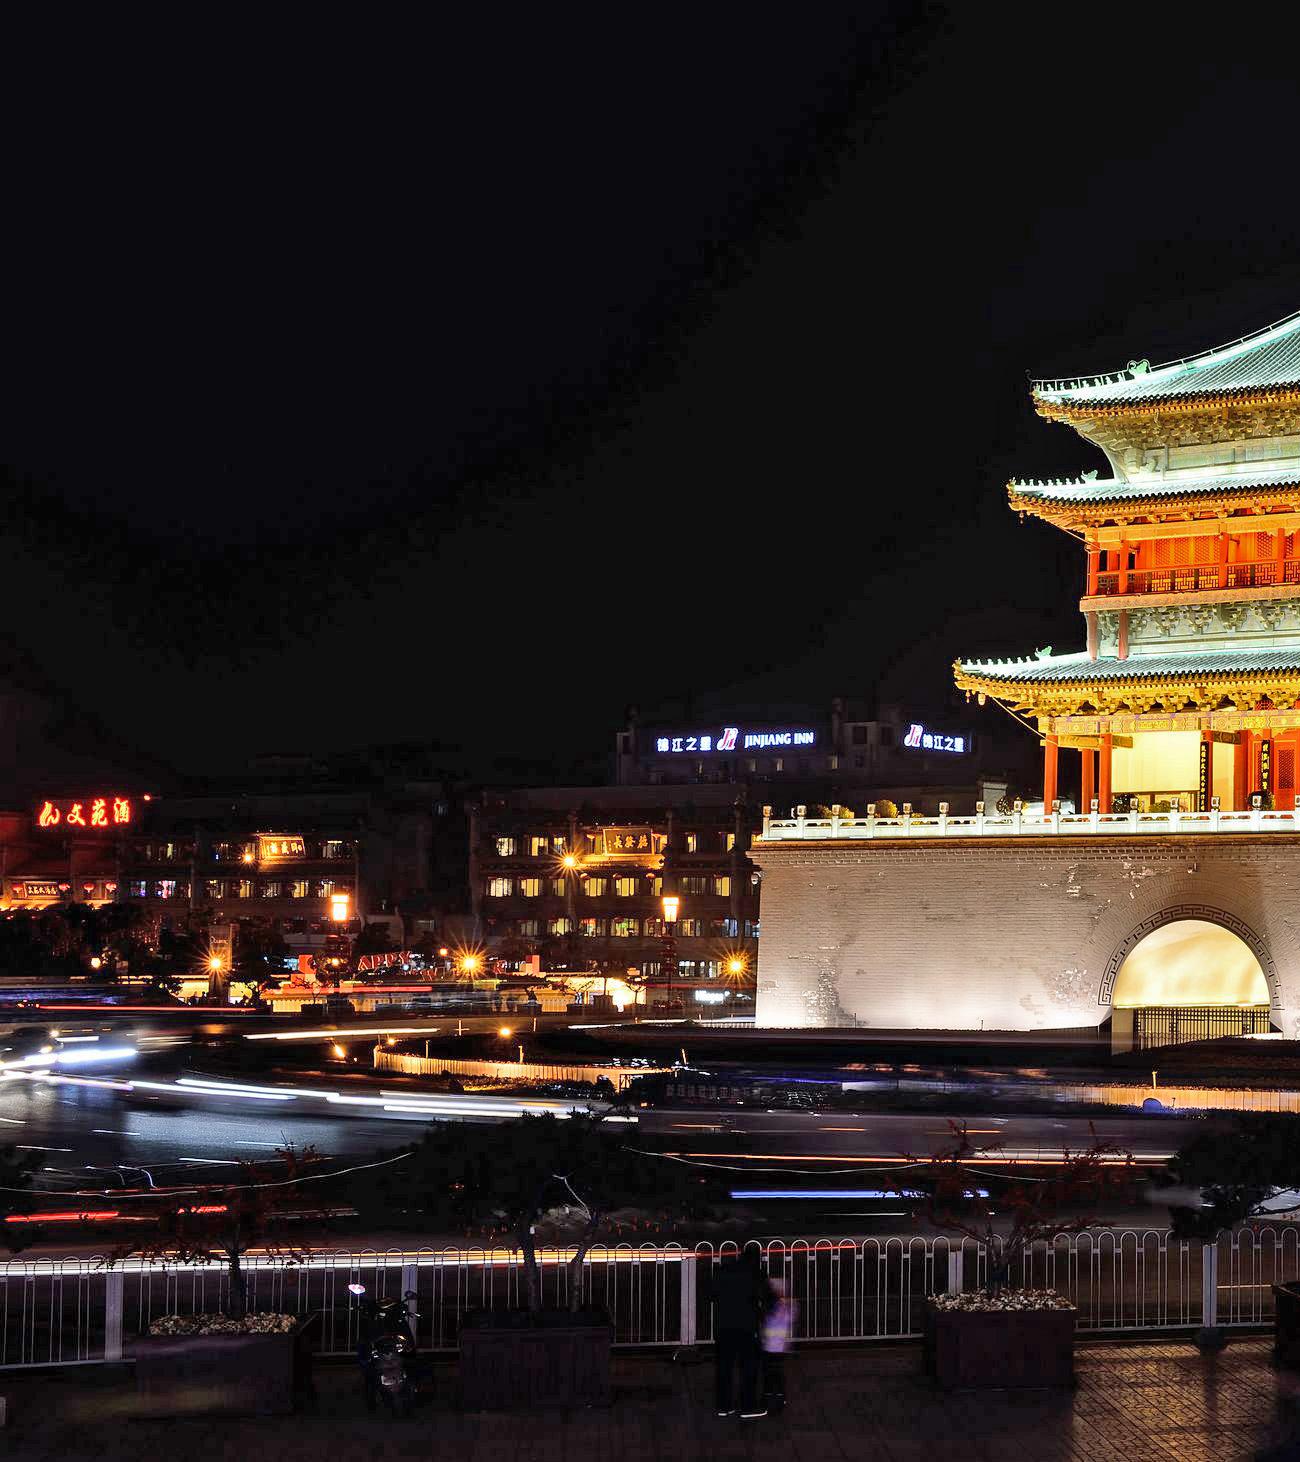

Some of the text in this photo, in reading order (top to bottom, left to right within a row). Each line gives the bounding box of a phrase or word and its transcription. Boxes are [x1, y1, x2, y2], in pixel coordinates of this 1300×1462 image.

[657, 737, 712, 752] 锦江之星
[744, 733, 792, 749] JINJIANG
[793, 732, 815, 745] INN
[922, 733, 965, 753] 锦江之星
